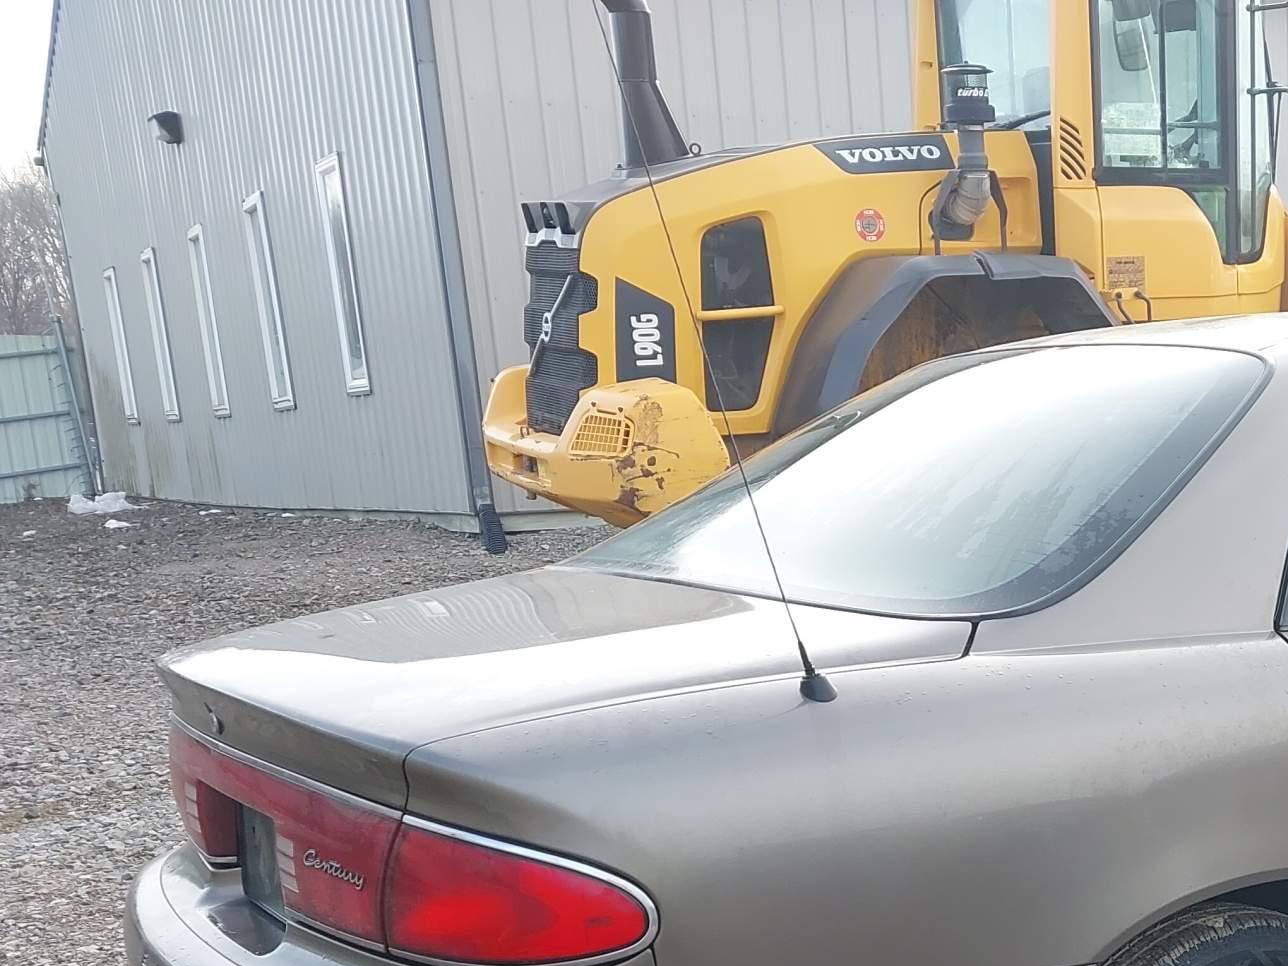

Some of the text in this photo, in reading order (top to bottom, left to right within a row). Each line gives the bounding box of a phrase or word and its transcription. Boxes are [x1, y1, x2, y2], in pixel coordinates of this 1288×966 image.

[835, 144, 941, 164] VOLVO
[629, 313, 664, 367] L90G
[303, 848, 364, 890] Century
